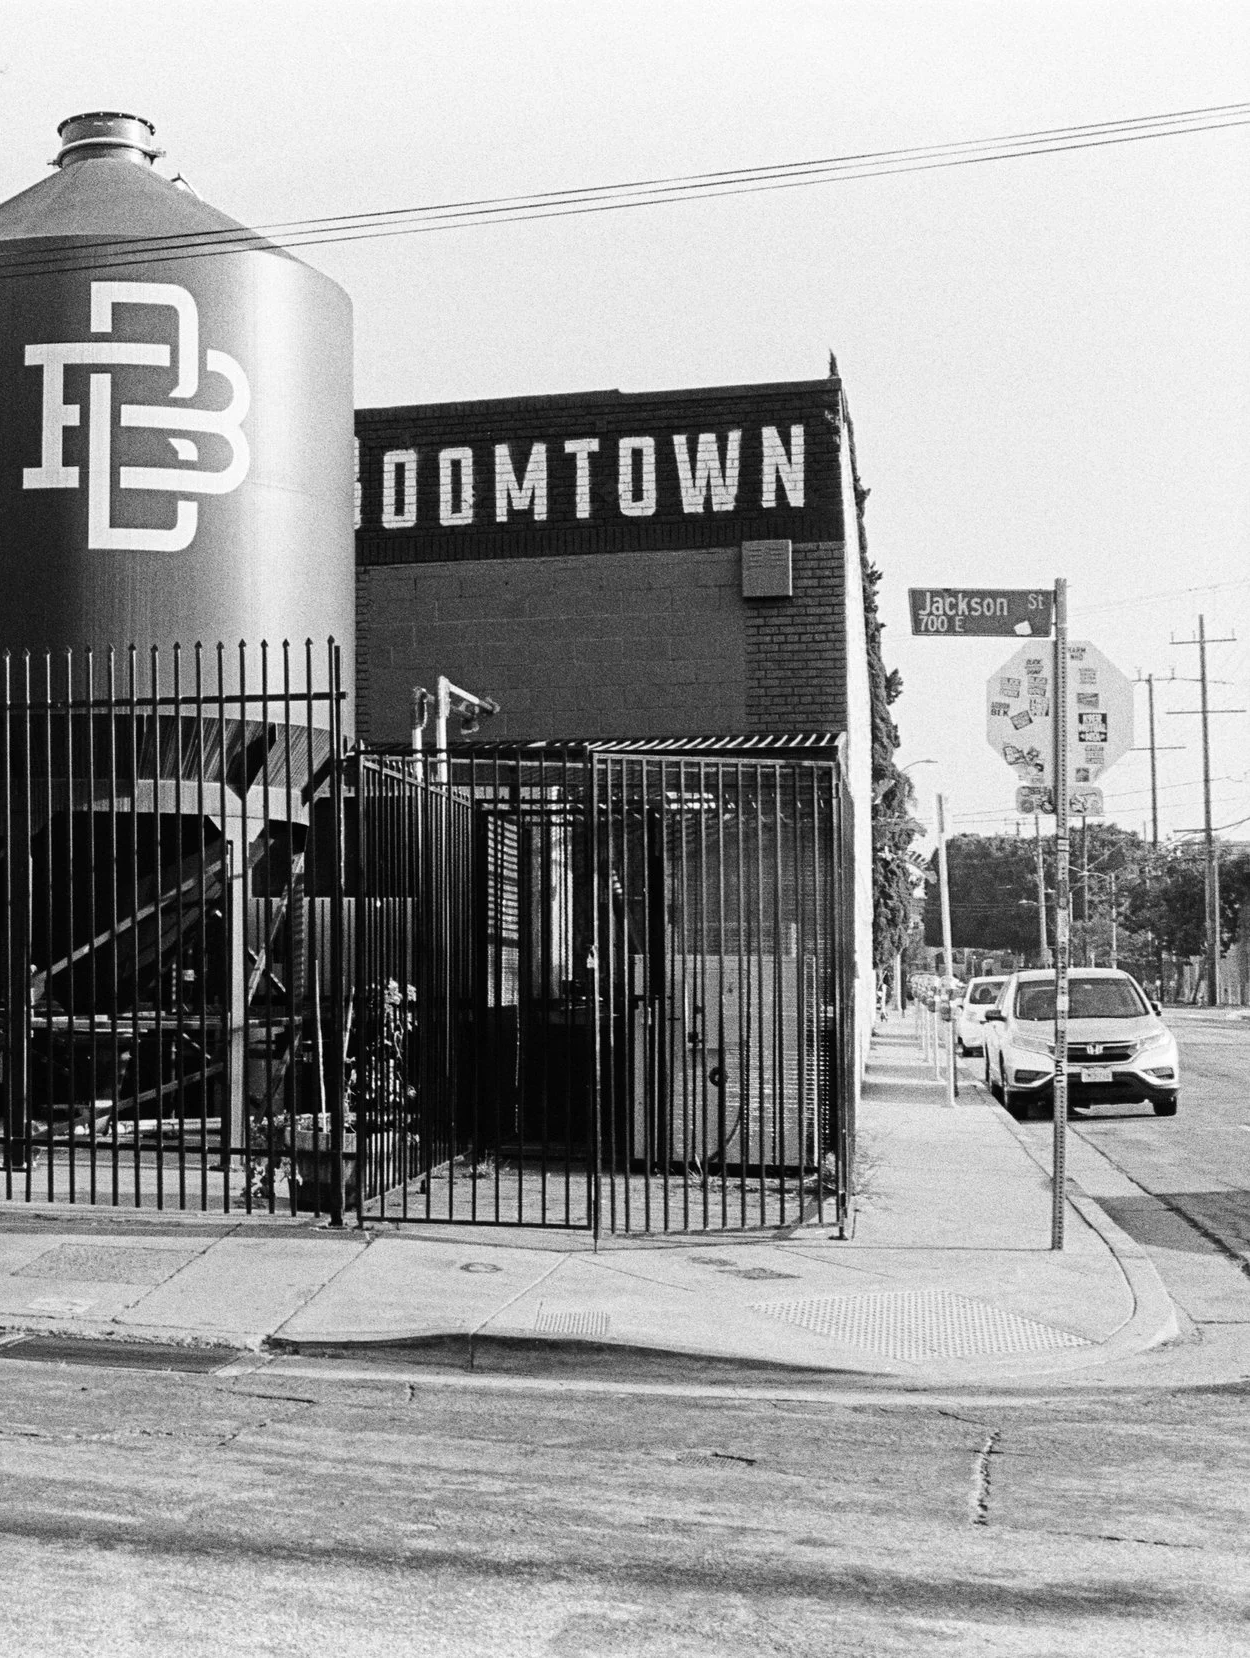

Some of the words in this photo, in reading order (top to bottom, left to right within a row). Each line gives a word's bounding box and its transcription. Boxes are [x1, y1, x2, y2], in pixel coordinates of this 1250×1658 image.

[354, 424, 805, 529] OOMTOWN
[918, 591, 1008, 616] Jackson
[1027, 593, 1044, 609] St
[918, 616, 949, 632] 700
[955, 616, 965, 632] E
